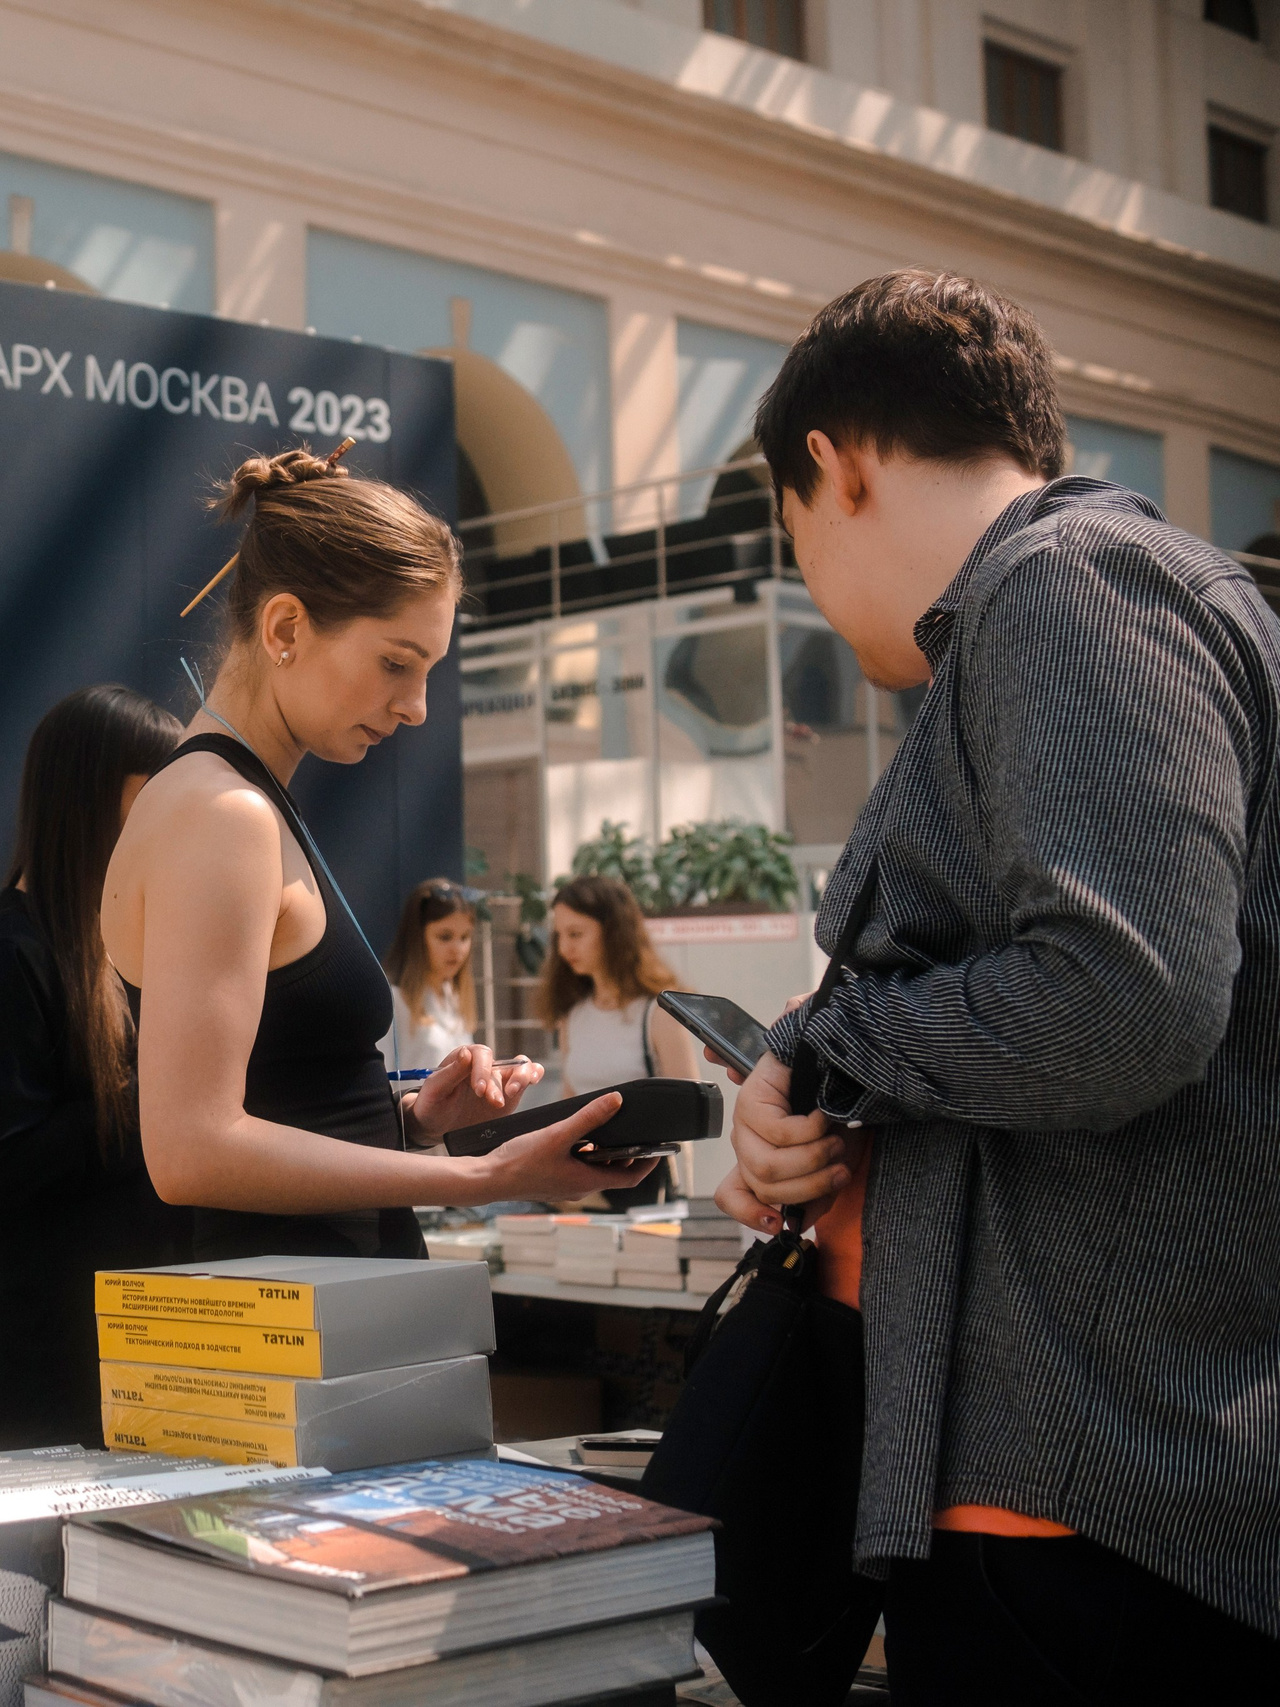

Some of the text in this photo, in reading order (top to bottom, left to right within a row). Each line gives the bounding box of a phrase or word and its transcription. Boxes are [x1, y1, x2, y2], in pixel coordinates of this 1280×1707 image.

[84, 354, 280, 427] МОСКВА
[286, 386, 392, 443] 2023
[104, 1278, 145, 1288] ЮРИЙ ВОЛЧОК
[122, 1294, 256, 1309] ИСТОРИЯ АРХИТЕКТУРЫ НОВЕЙШЕГО ВРЕМЕНИ
[122, 1303, 244, 1318] РАСШИРЕНИЕ ГОРИЗОНТОВ МЕТОДОЛОГИИ
[107, 1322, 148, 1332] ЮРИЙ ВОЛЧОК
[125, 1337, 174, 1348] ТЕКТОНИЧЕСКИЙ
[174, 1341, 200, 1351] ПОДХОД
[206, 1344, 241, 1353] ЗОДЧЕСТВЕ
[244, 1408, 268, 1417] ВОЛЧОК
[197, 1433, 220, 1444] ПОДХОД
[220, 1437, 268, 1451] ТЕКТОНИЧЕСКИЙ
